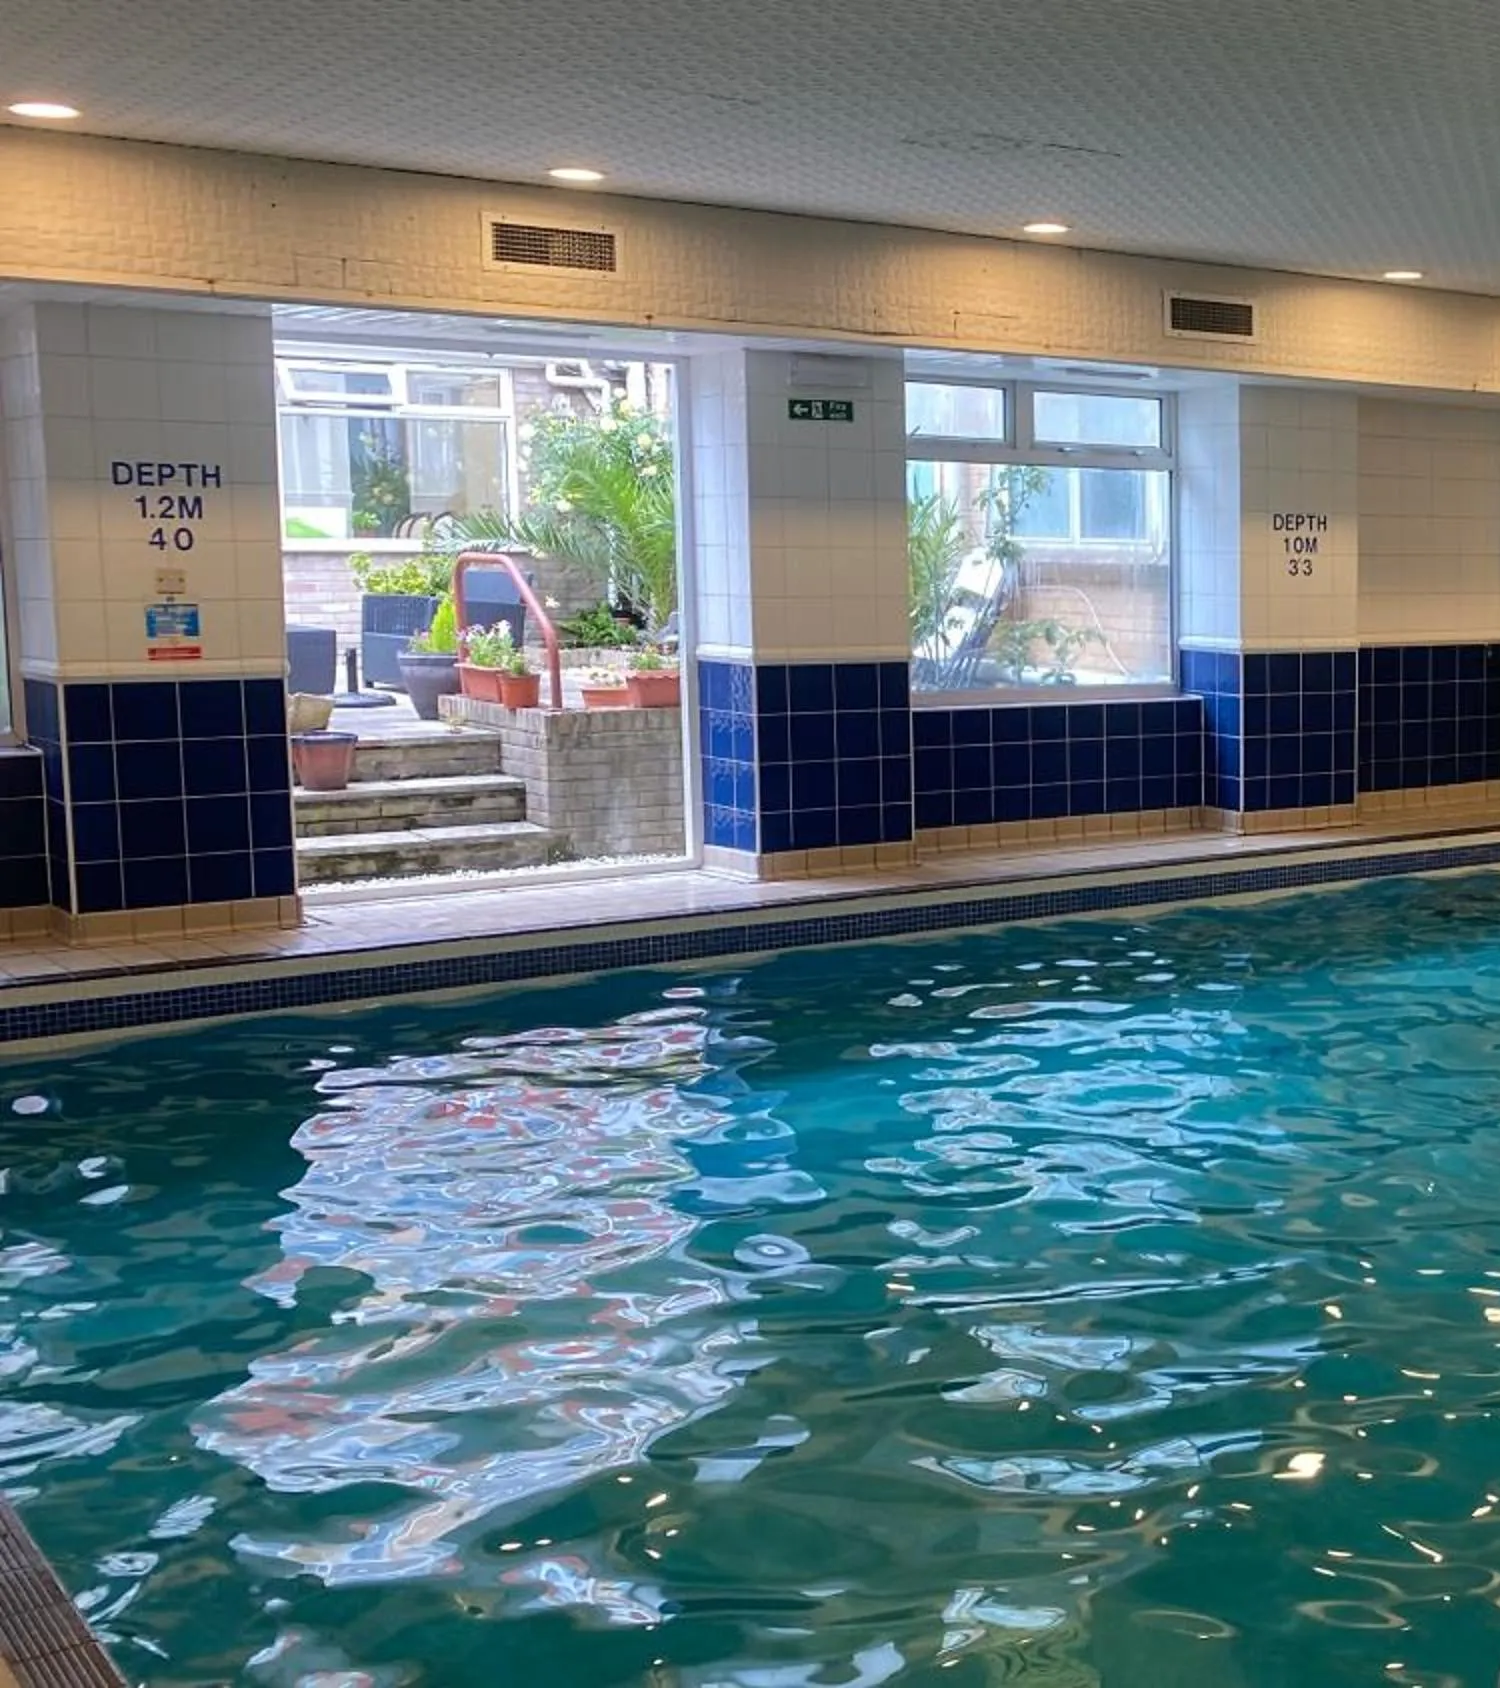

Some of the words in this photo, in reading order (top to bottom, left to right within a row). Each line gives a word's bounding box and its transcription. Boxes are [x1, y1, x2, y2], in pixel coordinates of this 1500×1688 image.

[111, 461, 221, 488] DEPTH
[134, 496, 203, 519] 1.2M
[1273, 513, 1327, 532] DEPTH
